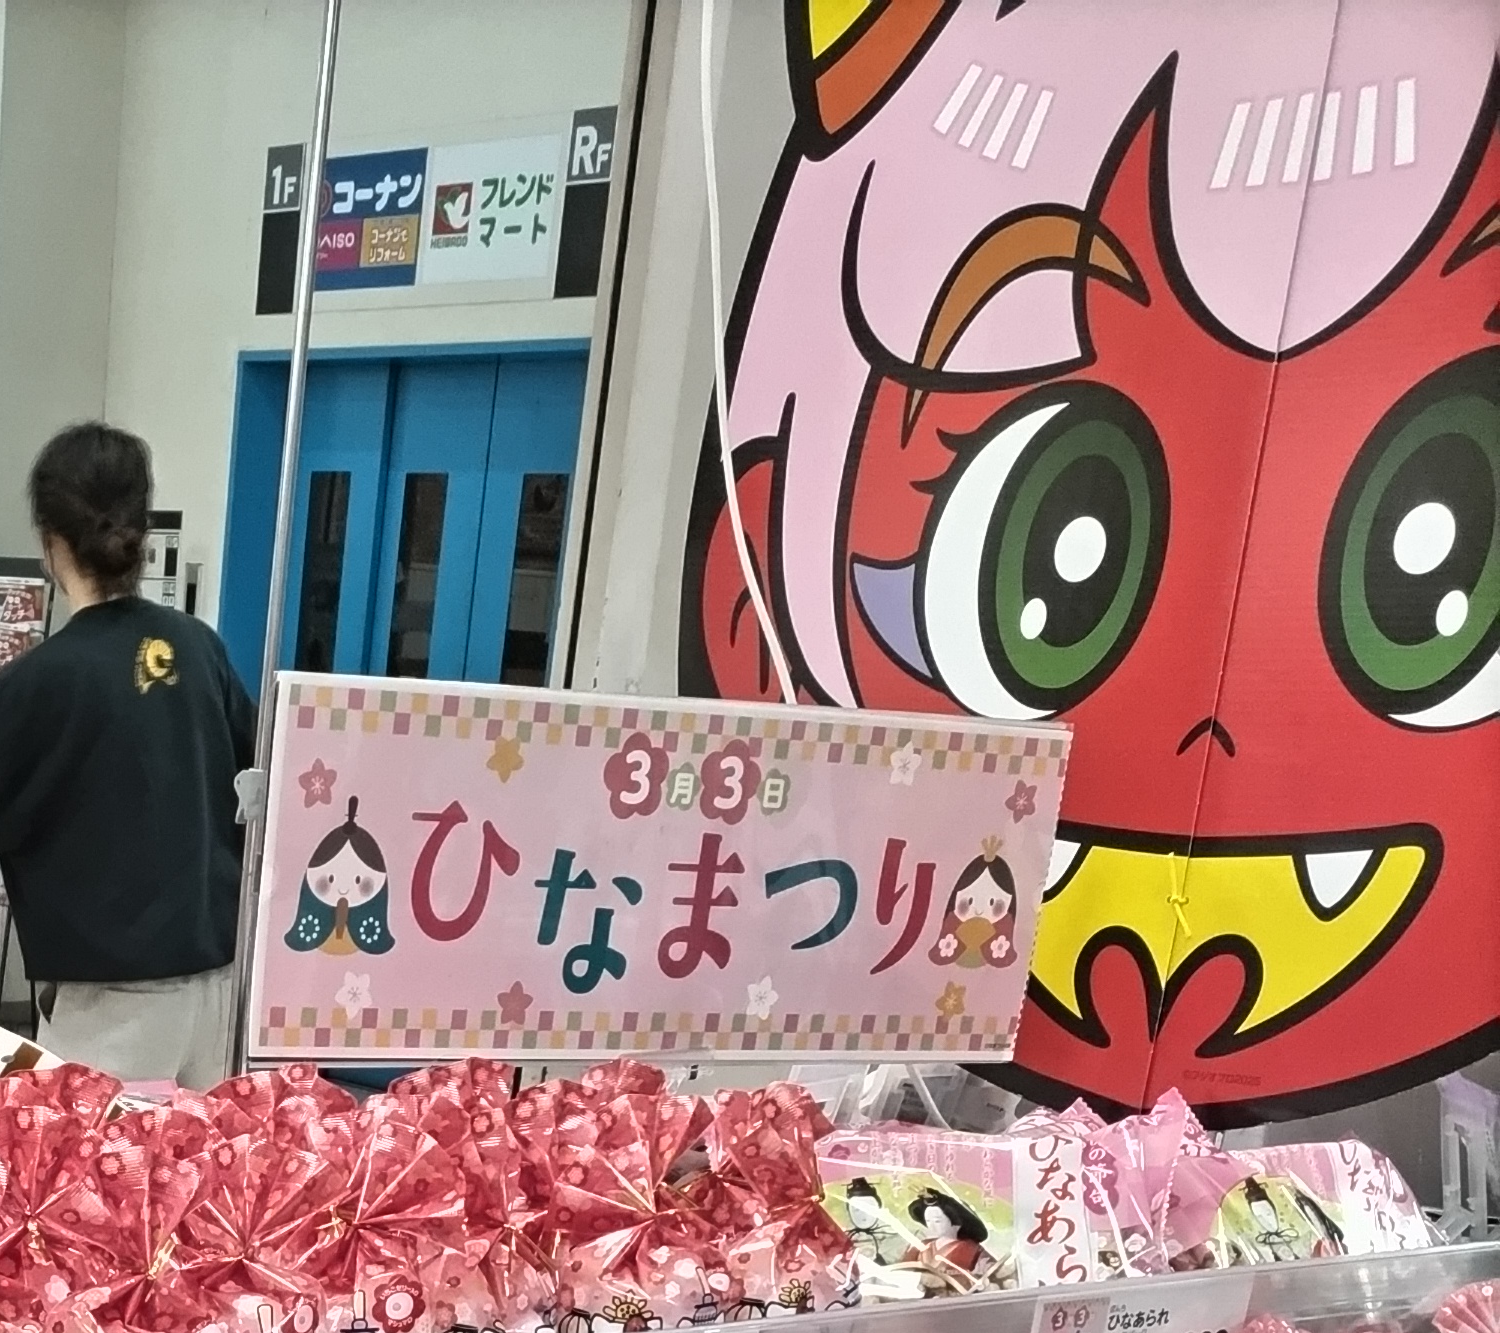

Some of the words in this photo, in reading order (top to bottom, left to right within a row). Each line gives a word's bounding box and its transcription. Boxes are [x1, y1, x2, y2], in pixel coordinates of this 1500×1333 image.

[571, 125, 612, 177] RF
[271, 164, 297, 206] 1F
[332, 173, 422, 214] コーナン
[480, 172, 555, 211] フレンド
[479, 213, 548, 249] マート
[622, 730, 786, 812] 3月3日
[410, 800, 938, 995] ひなまつり
[1107, 1307, 1170, 1331] ひなあられ
